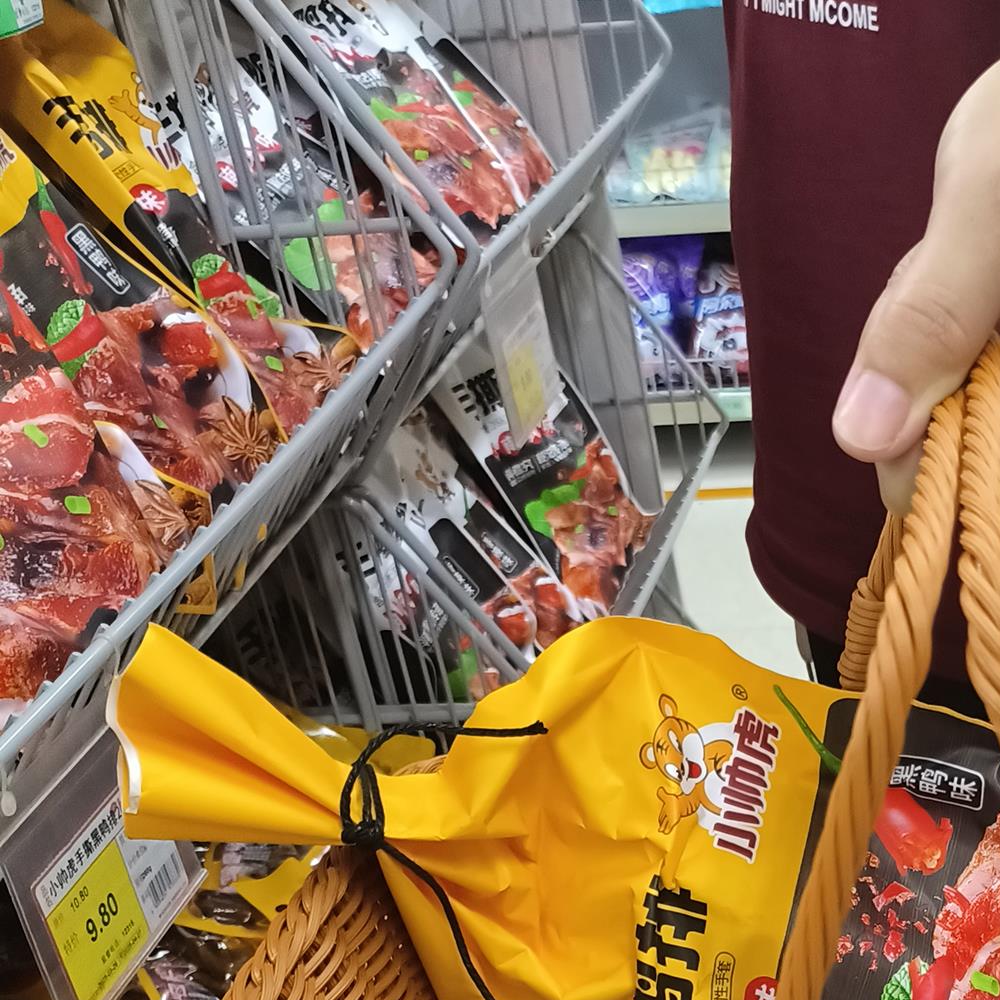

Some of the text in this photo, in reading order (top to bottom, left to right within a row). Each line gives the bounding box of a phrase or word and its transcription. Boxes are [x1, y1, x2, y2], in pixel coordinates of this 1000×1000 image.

[809, 0, 879, 32] MCOME
[713, 709, 779, 861] 小帅虎
[890, 764, 978, 802] 黑鸭味
[85, 892, 119, 942] 9.80
